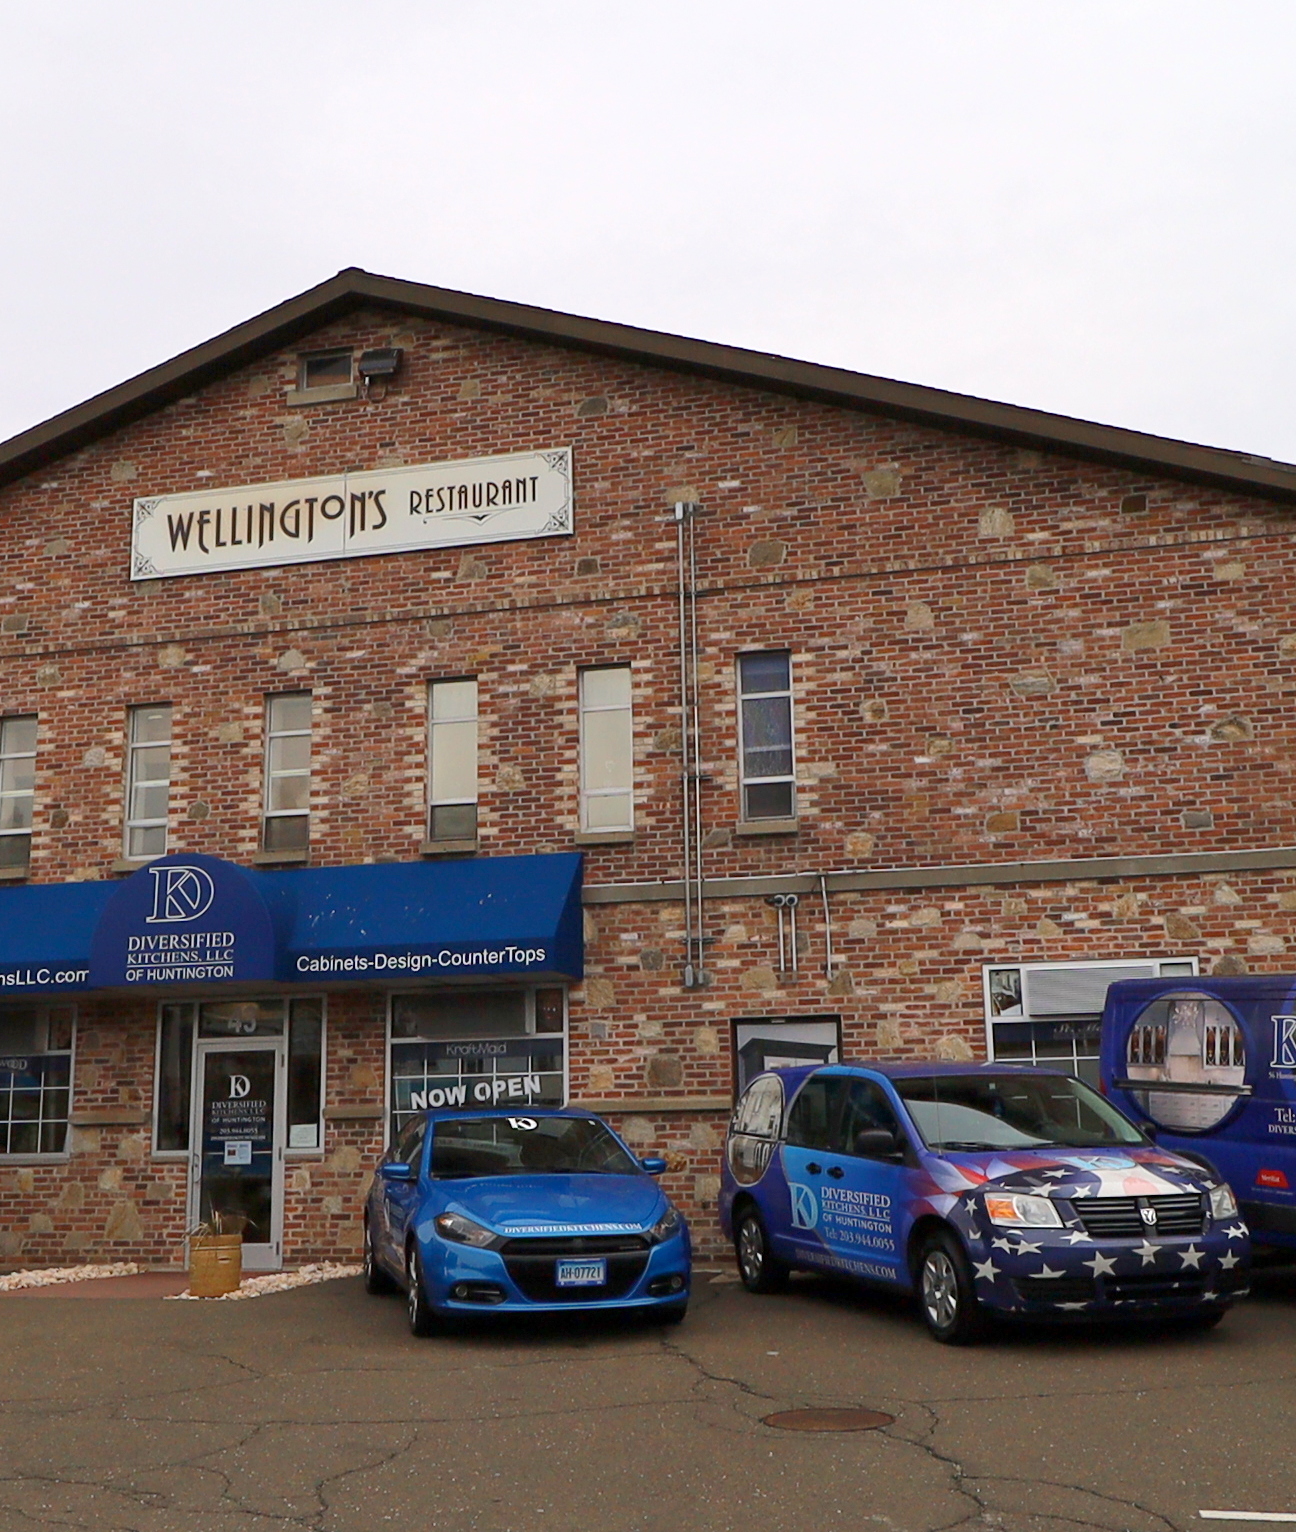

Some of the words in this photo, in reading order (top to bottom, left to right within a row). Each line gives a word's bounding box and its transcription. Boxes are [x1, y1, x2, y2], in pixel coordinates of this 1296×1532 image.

[167, 489, 386, 555] WELLINGTON'S
[409, 476, 539, 516] RESTAURANT
[128, 932, 234, 951] DIVERSIFIED
[206, 949, 234, 961] LLC
[296, 946, 546, 972] Cabinets-Design-CounterTops
[126, 969, 144, 981] OF
[147, 965, 234, 980] HUNTINGTON
[446, 1041, 507, 1056] KraftMaid
[411, 1085, 466, 1110] NOW
[474, 1075, 541, 1101] OPEN
[212, 1100, 267, 1110] DIVERSIFIED
[1274, 1108, 1296, 1123] Tel:
[821, 1186, 891, 1208] DIVERSIFIED
[504, 1223, 643, 1234] DIVERSIFIEDKITCHENS.COM
[823, 1212, 832, 1222] OF
[835, 1214, 892, 1234] HUNTINGTON
[840, 1230, 895, 1252] 203.944.0055
